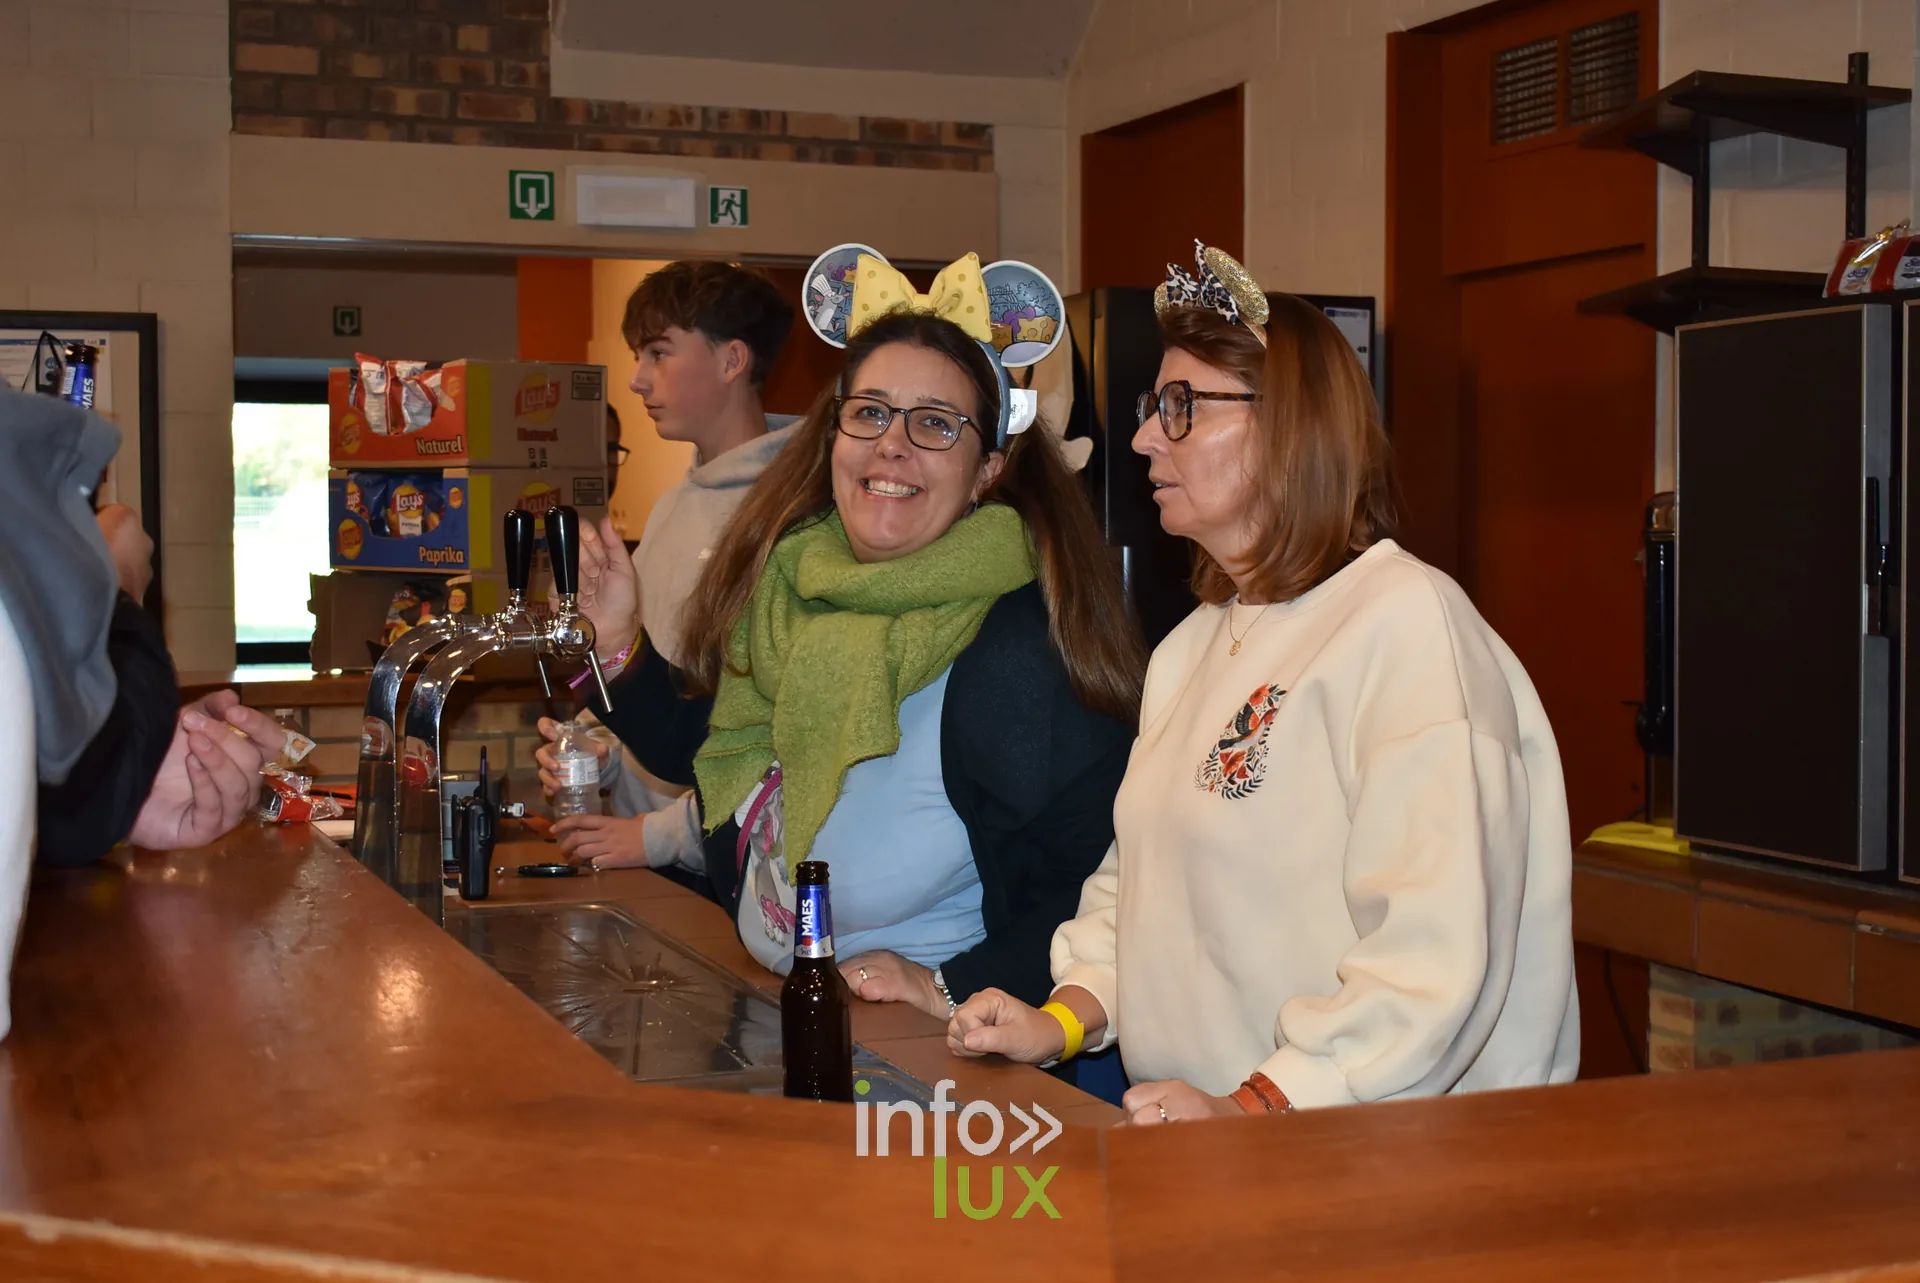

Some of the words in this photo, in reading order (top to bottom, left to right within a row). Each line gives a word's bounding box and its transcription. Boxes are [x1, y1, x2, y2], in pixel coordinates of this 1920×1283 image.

[416, 435, 462, 455] Naturel
[396, 492, 424, 511] Lay's
[418, 546, 464, 566] Paprika
[801, 899, 813, 936] MAES
